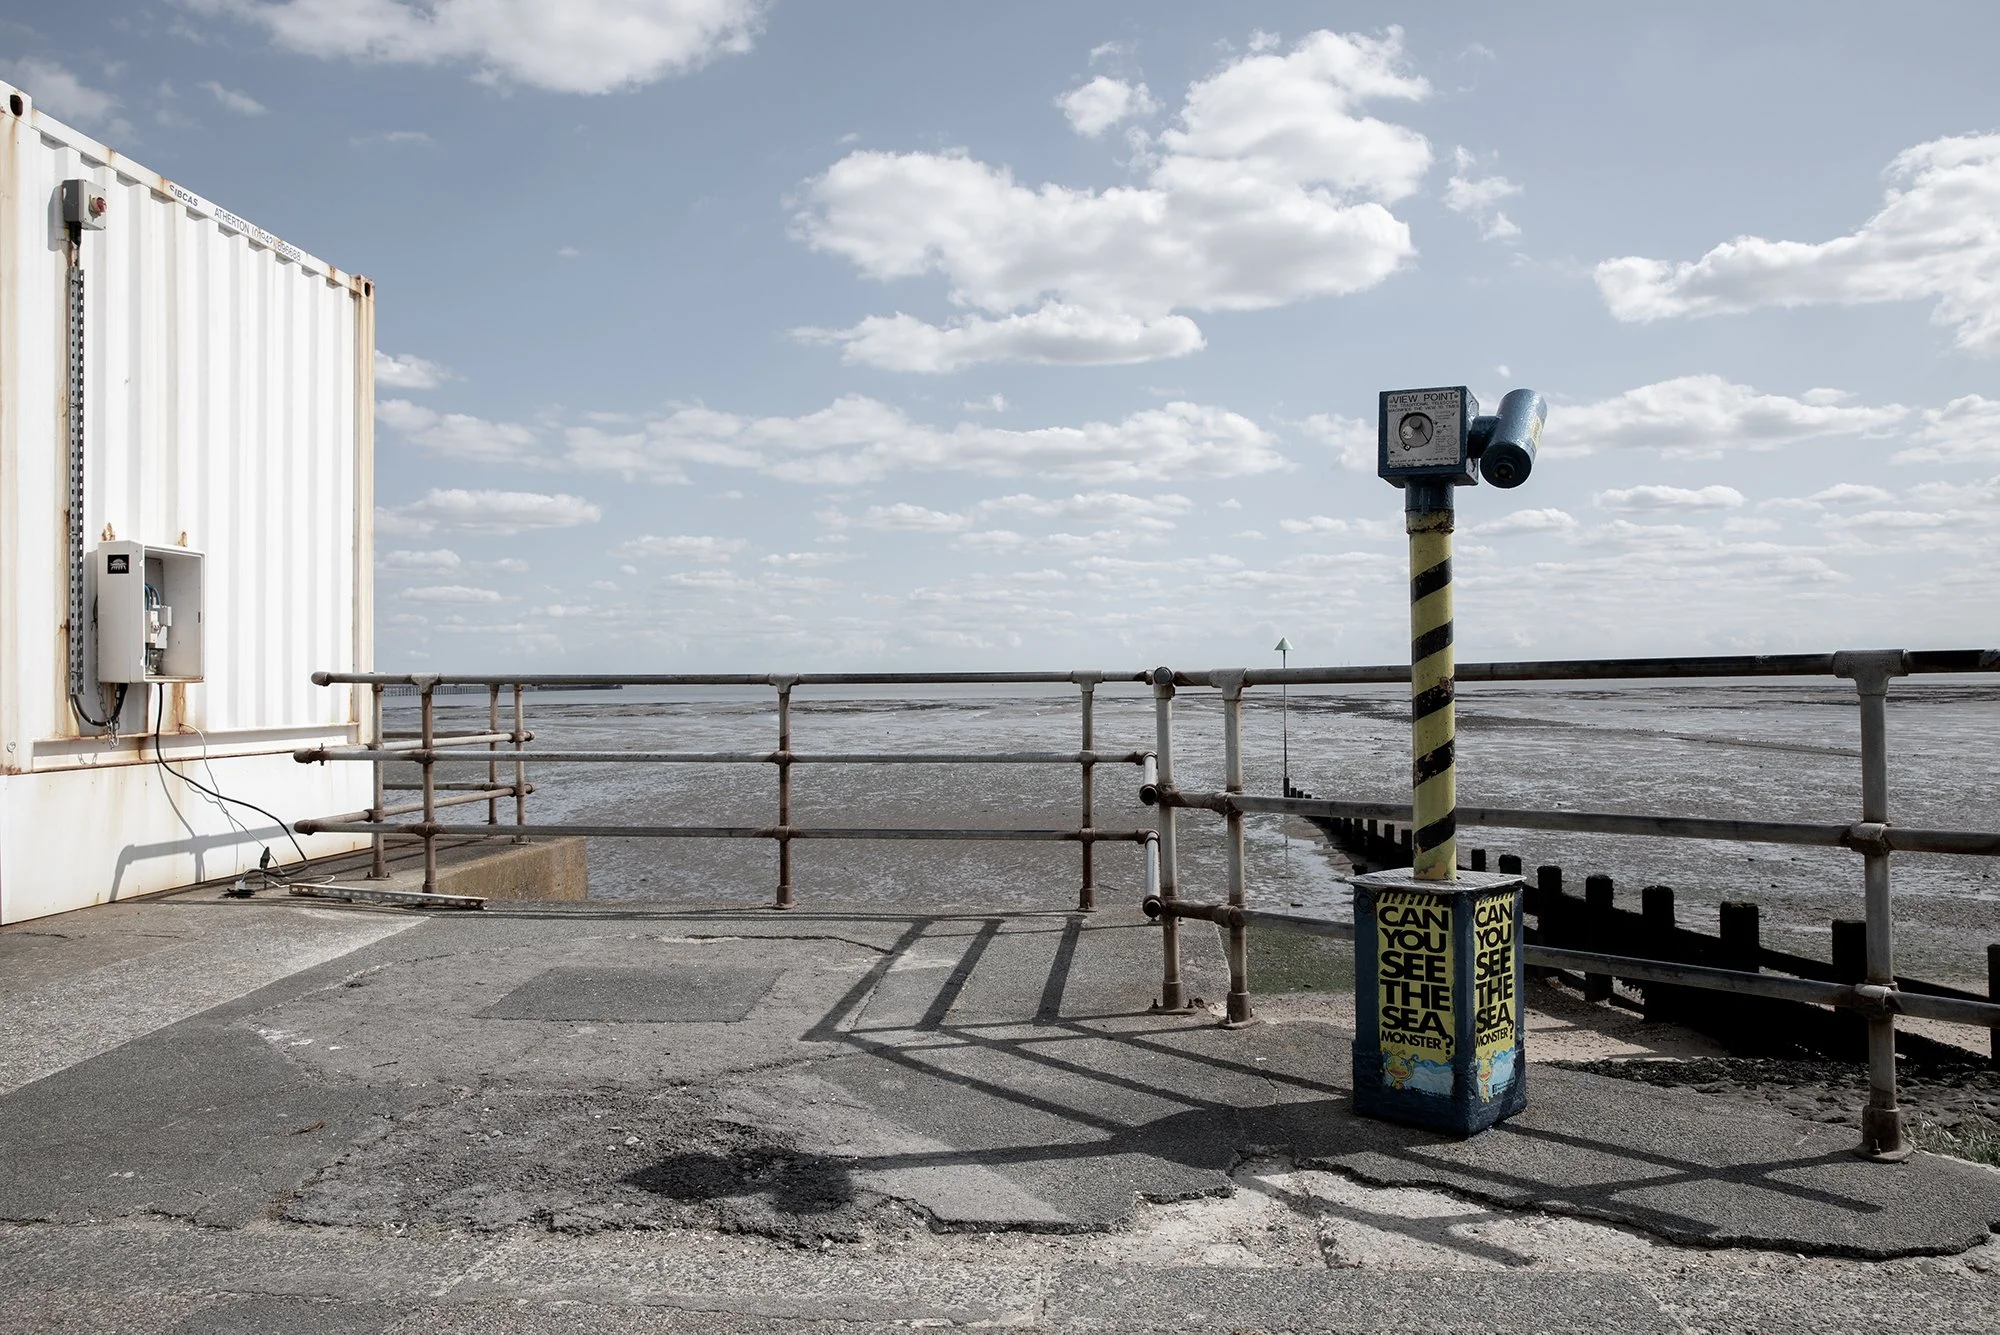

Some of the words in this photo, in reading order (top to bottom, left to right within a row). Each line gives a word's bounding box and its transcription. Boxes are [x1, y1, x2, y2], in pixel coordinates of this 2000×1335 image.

[215, 208, 250, 234] ATHERTON
[1393, 395, 1418, 404] VIEW
[1423, 392, 1455, 401] POINT
[1378, 905, 1449, 931] CAN
[1475, 901, 1513, 928] CAN
[1380, 928, 1447, 953] YOU
[1476, 923, 1511, 950] YOU
[1380, 950, 1447, 984] SEE
[1476, 946, 1511, 981] SEE
[1380, 979, 1450, 1012] THE
[1476, 974, 1513, 1008] THE
[1381, 1005, 1447, 1037] SEA
[1476, 1002, 1511, 1034] SEA
